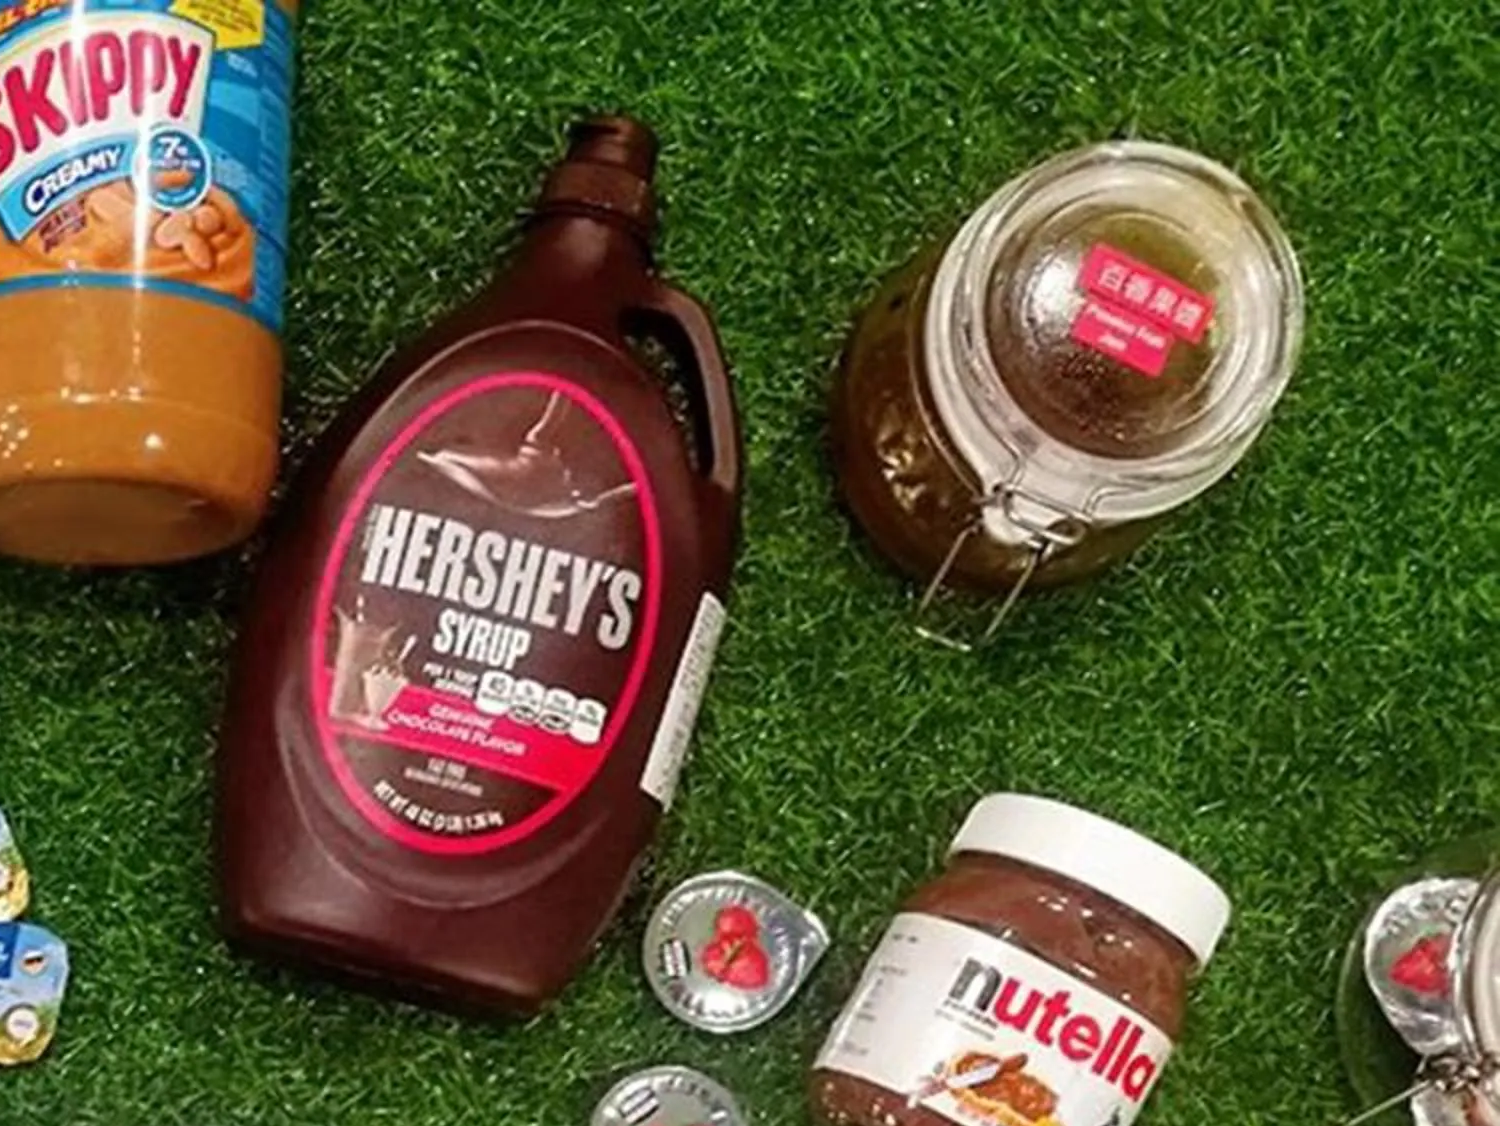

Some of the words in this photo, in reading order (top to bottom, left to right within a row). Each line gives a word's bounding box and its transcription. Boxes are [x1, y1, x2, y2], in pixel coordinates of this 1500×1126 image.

[24, 145, 124, 216] CREAMY
[362, 506, 642, 649] HERSHEY'S
[432, 609, 531, 669] SYRUP
[387, 711, 470, 742] CHOCOLATE
[472, 731, 527, 756] FLAVOR
[947, 957, 1156, 1102] nutella
